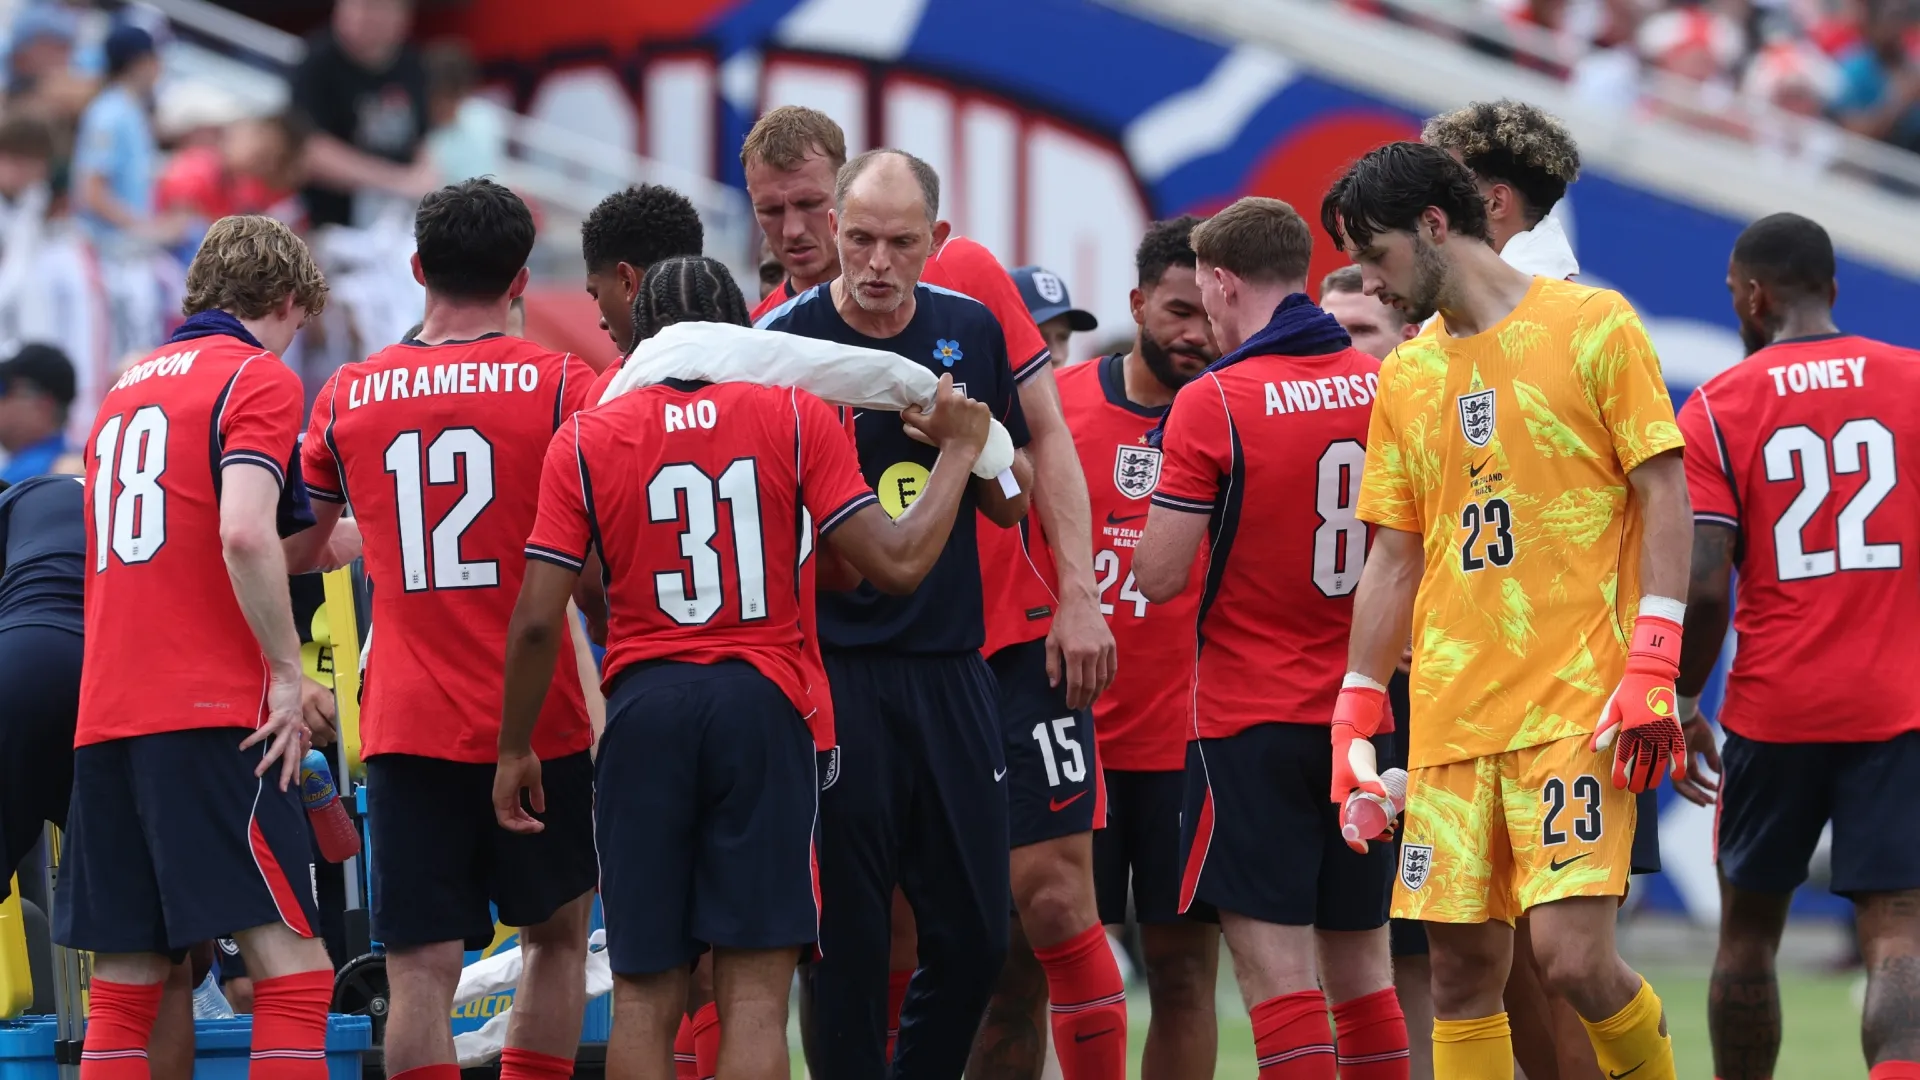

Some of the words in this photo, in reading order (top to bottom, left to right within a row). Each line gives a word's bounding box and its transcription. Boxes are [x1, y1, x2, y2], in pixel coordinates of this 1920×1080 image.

[108, 350, 200, 391] ORDON
[348, 360, 539, 410] LIVRAMENTO
[1264, 371, 1380, 416] ANDERSO
[1767, 356, 1867, 397] TONEY
[664, 399, 718, 433] RIO
[93, 405, 170, 573] 18
[383, 426, 501, 593] 12
[897, 477, 917, 509] E
[1312, 438, 1368, 598] 8
[1761, 417, 1902, 582] 22
[646, 456, 768, 626] 31
[1103, 526, 1119, 536] NEW
[1461, 498, 1515, 573] 23
[1094, 549, 1151, 618] 24
[1650, 634, 1665, 648] JT
[1032, 716, 1087, 788] 15
[1541, 774, 1603, 847] 23
